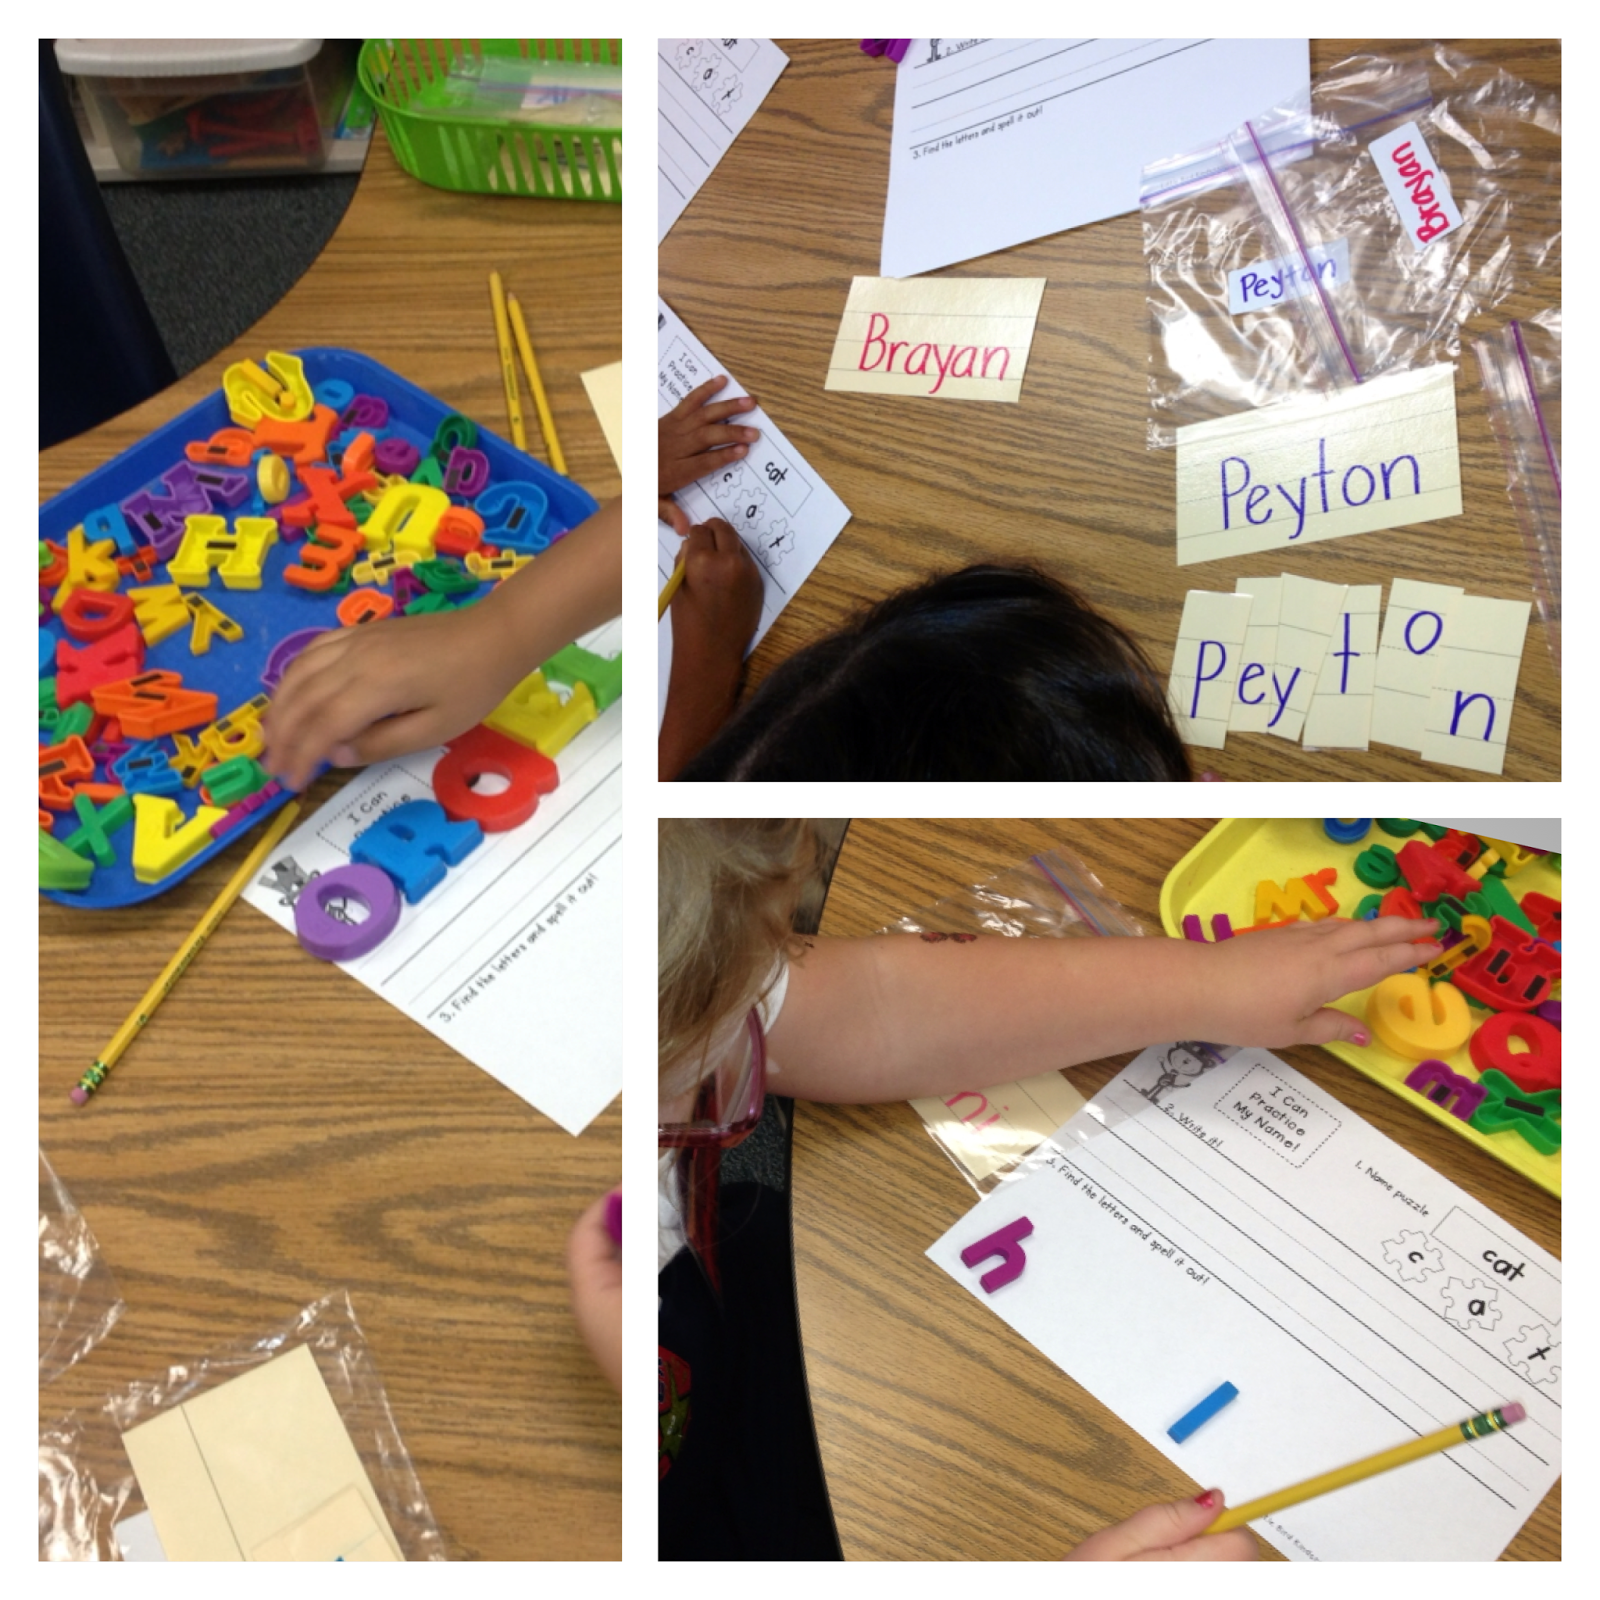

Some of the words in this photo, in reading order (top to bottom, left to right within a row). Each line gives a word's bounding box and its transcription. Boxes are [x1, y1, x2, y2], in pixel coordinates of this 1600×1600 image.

[923, 141, 940, 156] Find
[941, 139, 953, 150] the
[955, 130, 980, 145] letters
[981, 121, 996, 136] and
[997, 114, 1015, 132] spell
[1391, 140, 1450, 244] Brayan
[1239, 257, 1338, 303] Peyton
[684, 358, 698, 376] Can
[858, 312, 1011, 395] Brayan
[765, 461, 789, 486] cat
[1220, 437, 1422, 541] Peyton
[360, 791, 388, 814] Can
[451, 985, 479, 1011] Find
[475, 973, 496, 989] the
[491, 943, 528, 973] letters
[526, 922, 547, 944] and
[546, 902, 568, 925] spell
[1248, 1091, 1306, 1137] Practice
[1268, 1086, 1284, 1099] I
[1282, 1096, 1309, 1119] Can
[1178, 1113, 1207, 1139] Write
[1233, 1101, 1254, 1121] My
[1253, 1116, 1301, 1152] Name!
[1057, 1164, 1083, 1186] Find
[1081, 1183, 1097, 1200] the
[1098, 1195, 1129, 1226] letters
[1129, 1223, 1153, 1241] and
[1150, 1240, 1176, 1259] spell
[1364, 1166, 1394, 1191] Name
[1393, 1189, 1430, 1218] puzzle
[1407, 1250, 1424, 1264] c
[1481, 1249, 1526, 1282] cat
[1467, 1298, 1486, 1316] a
